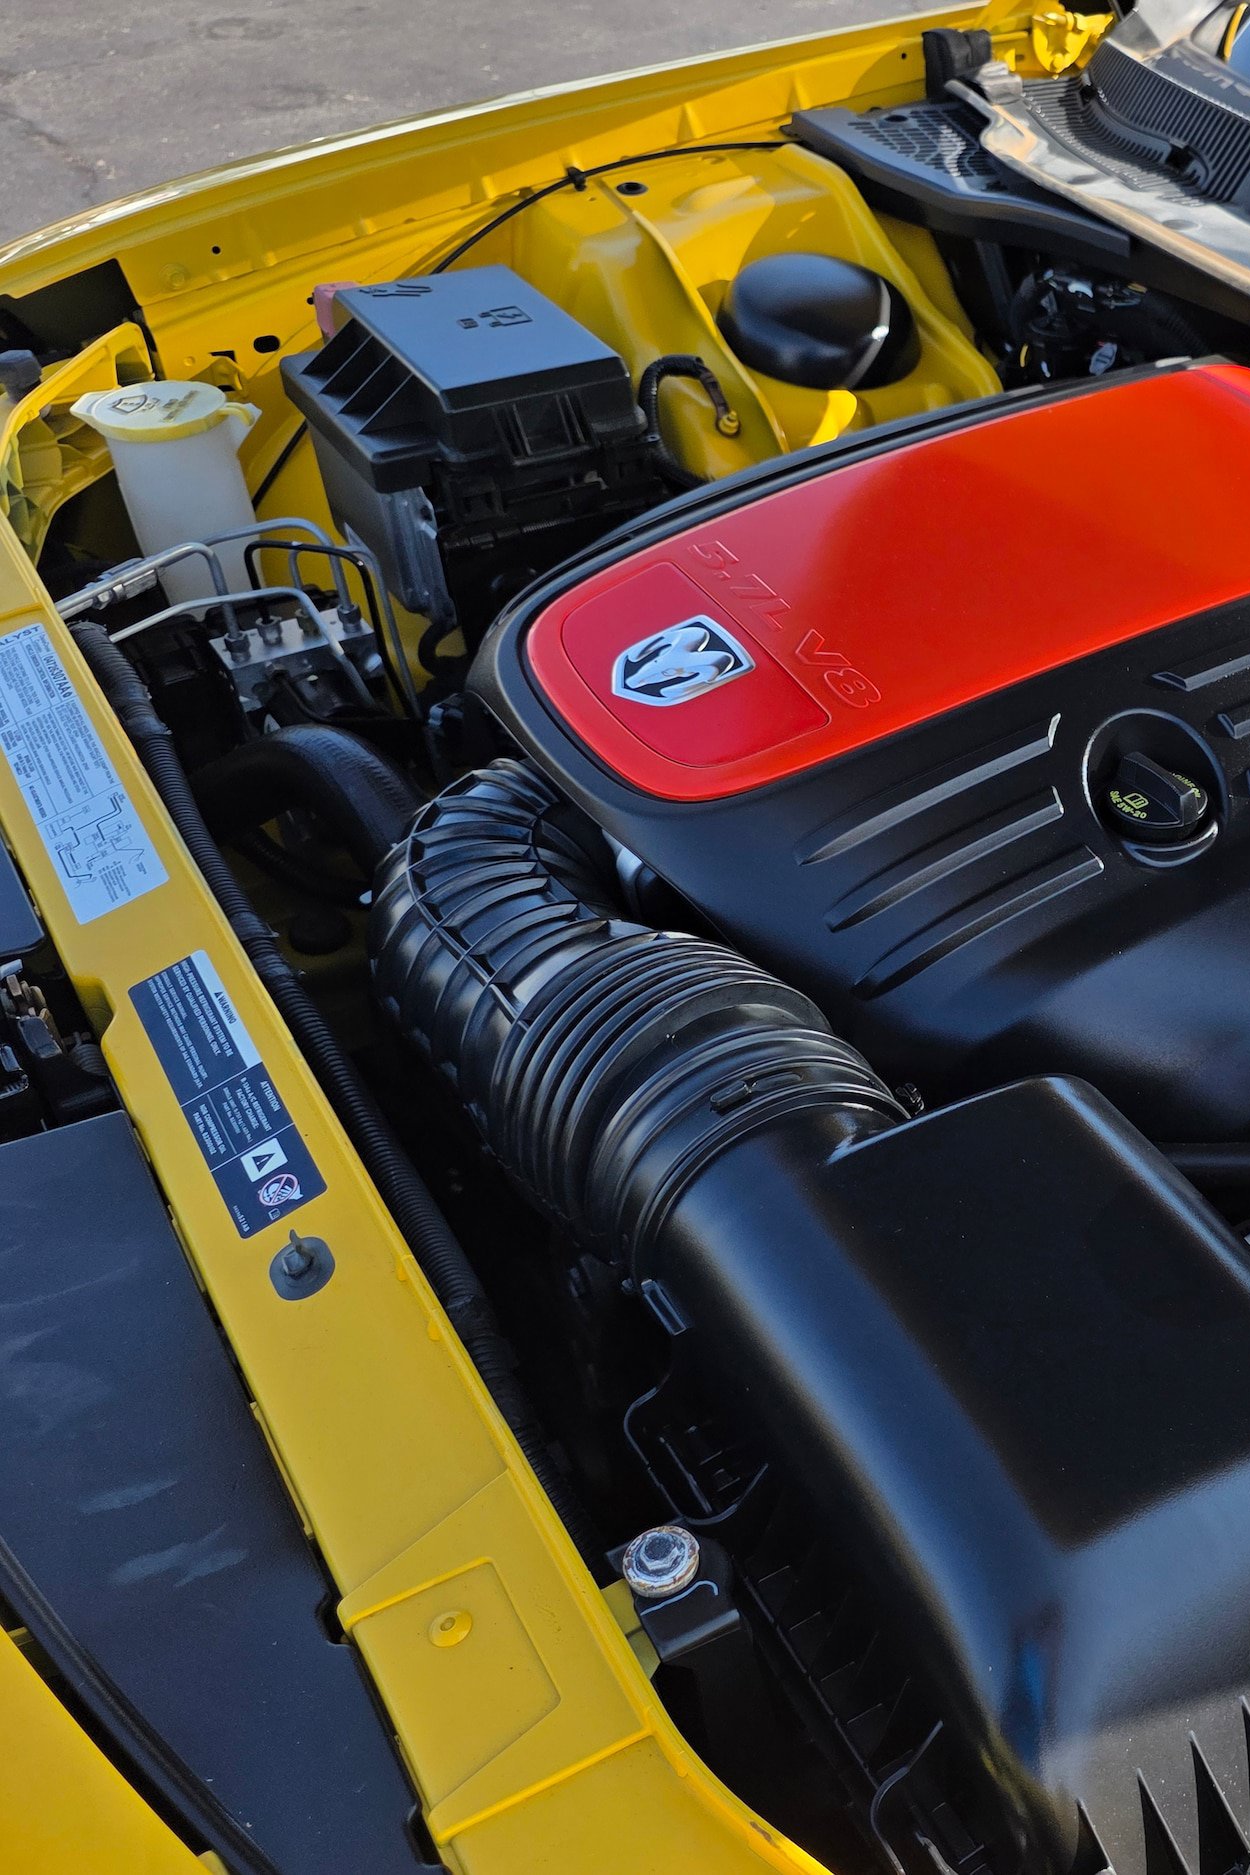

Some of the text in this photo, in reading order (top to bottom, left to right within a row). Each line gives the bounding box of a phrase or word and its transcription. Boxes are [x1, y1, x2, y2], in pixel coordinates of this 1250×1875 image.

[687, 540, 882, 710] 5.7L V8
[216, 996, 237, 1025] WARNING
[222, 1042, 230, 1050] TO
[259, 1079, 281, 1112] ATTENTION
[192, 1112, 203, 1125] PART
[203, 1113, 224, 1146] COMPRESSOR
